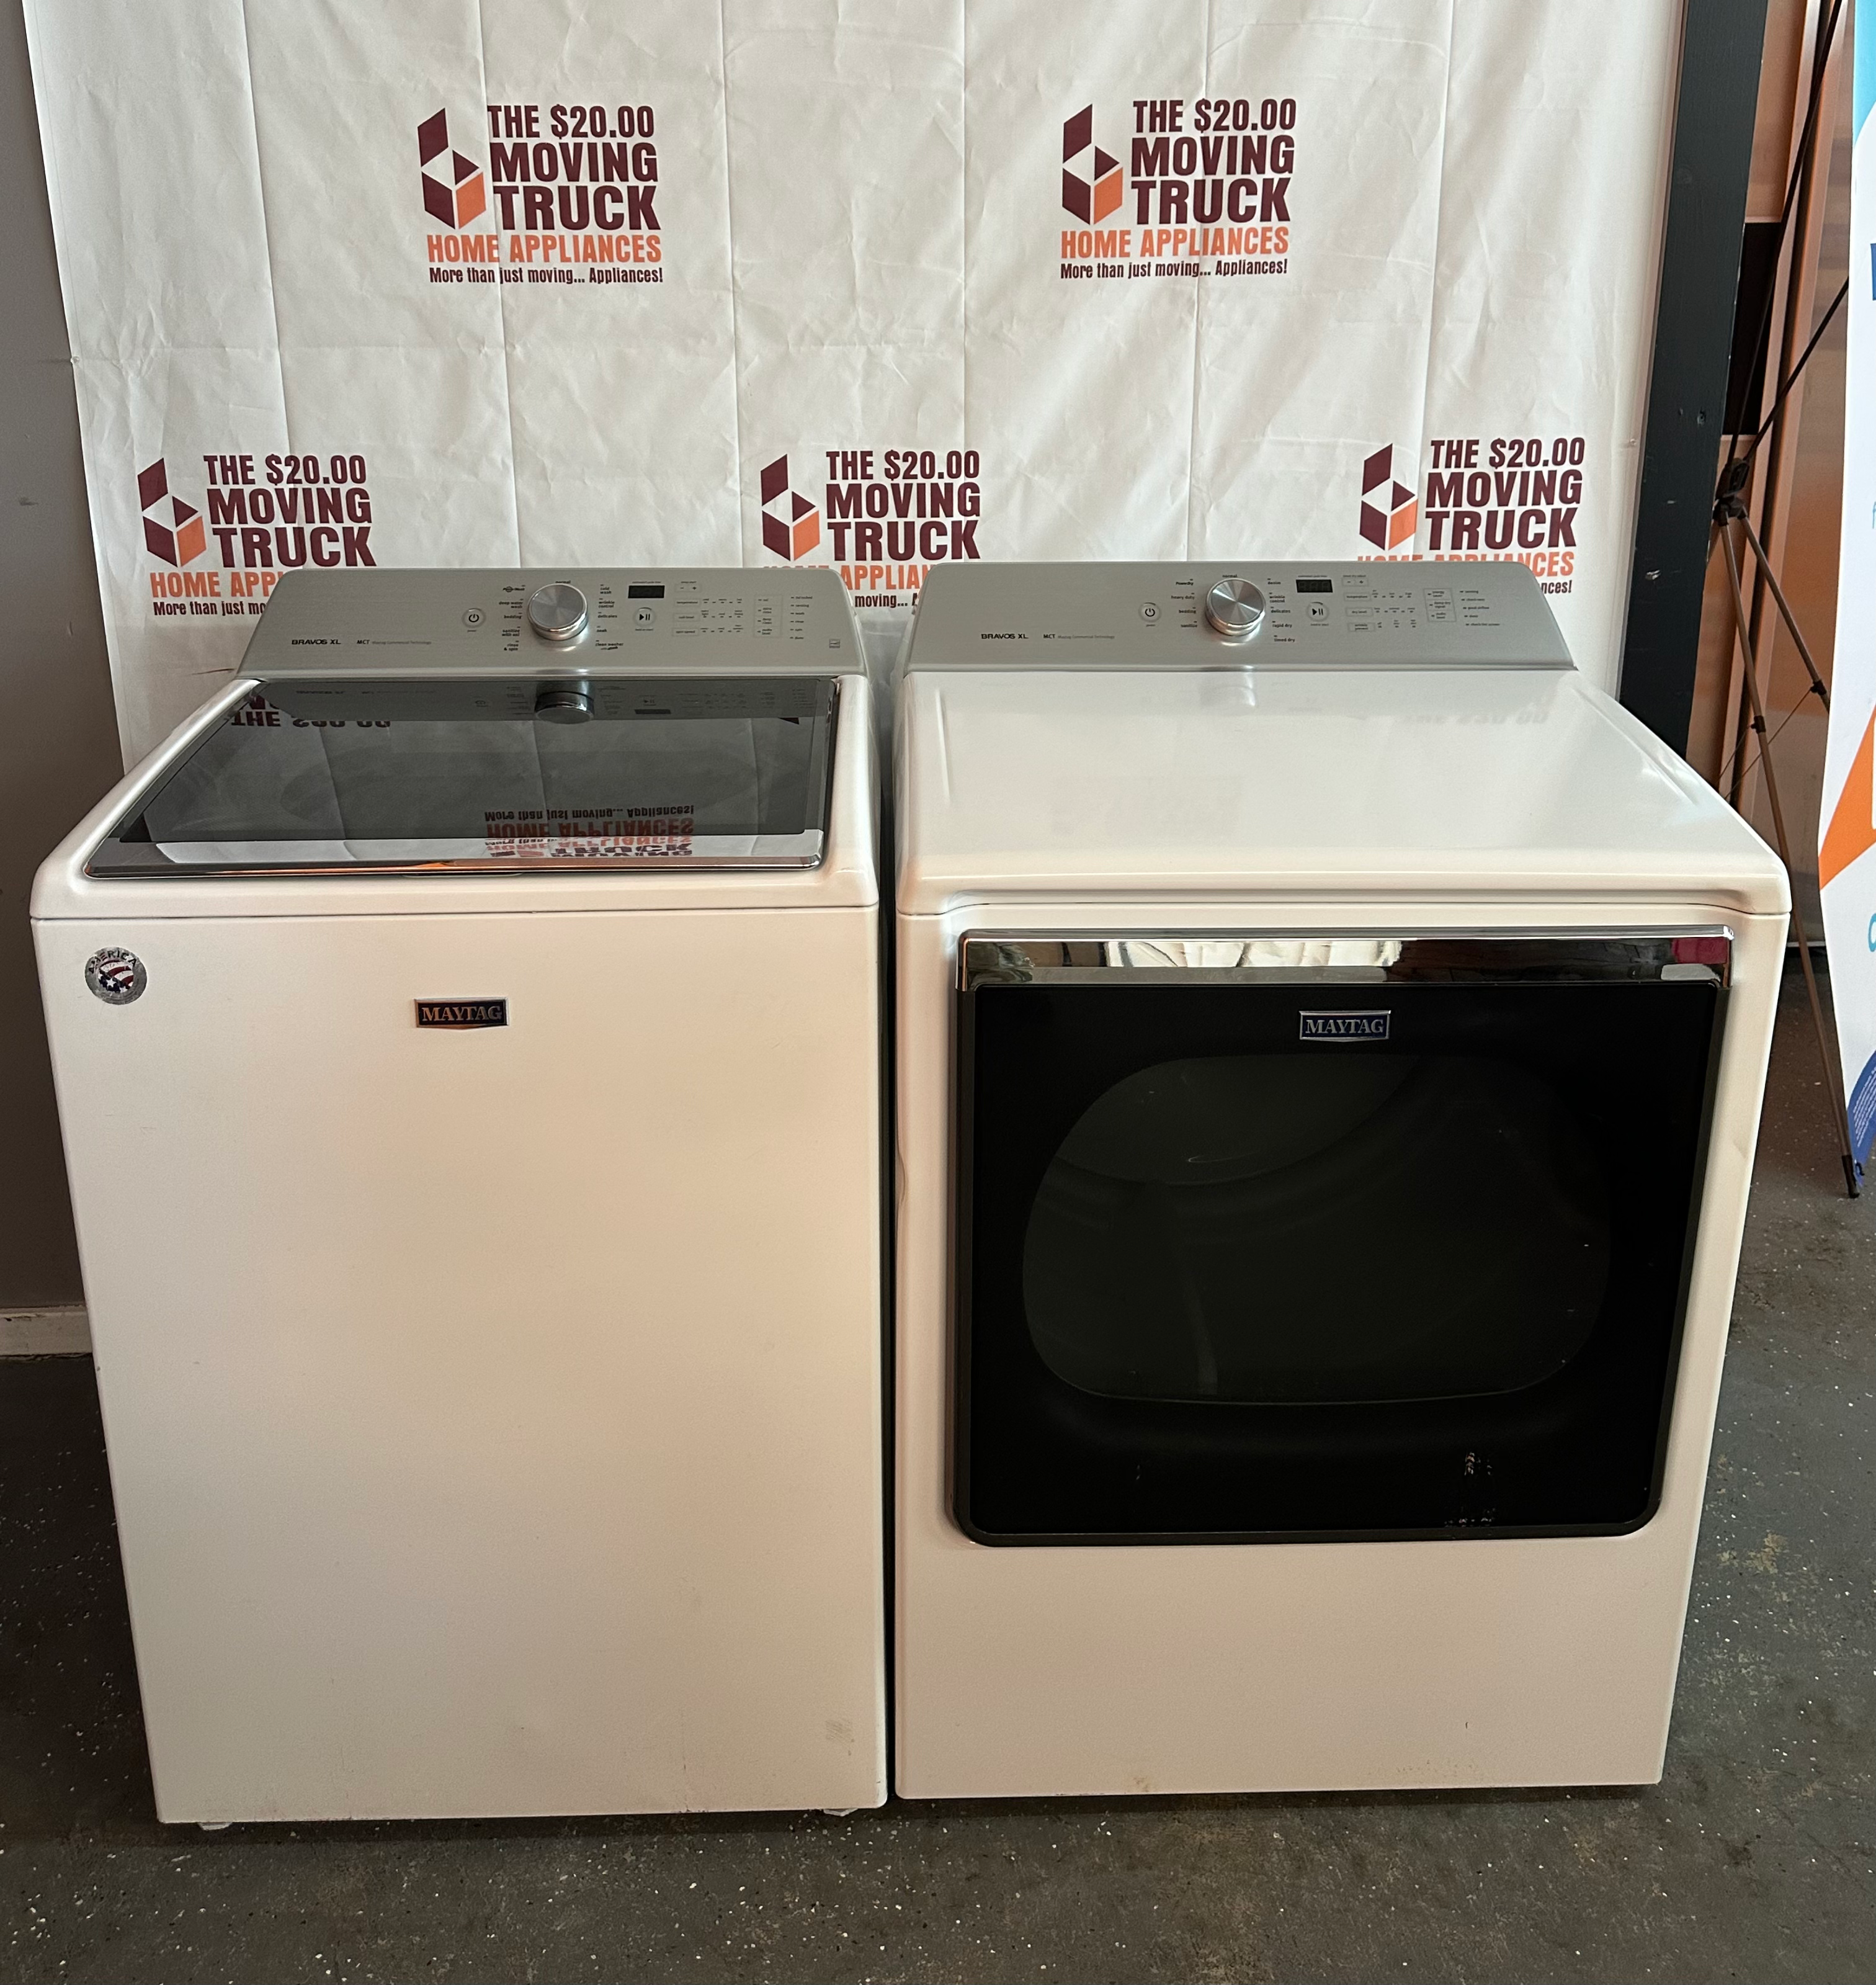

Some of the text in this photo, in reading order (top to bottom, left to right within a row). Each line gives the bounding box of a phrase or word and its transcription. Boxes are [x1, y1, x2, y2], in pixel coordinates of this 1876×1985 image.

[487, 104, 654, 140] THE $20.00
[1133, 98, 1297, 133] THE $20.00
[489, 142, 658, 182] MOVING
[1131, 135, 1295, 177] MOVING
[493, 185, 661, 231] TRUCK
[1131, 177, 1291, 225] TRUCK
[427, 235, 661, 262] HOME APPLIANCES
[1061, 226, 1289, 259] HOME APPLIANCES
[429, 267, 663, 284] More than just moving... Appliances!
[1060, 259, 1287, 279] More than just moving... Appliances!
[203, 454, 366, 486] THE $20.00
[826, 449, 980, 481] THE $20.00
[1431, 437, 1585, 469] THE $20.00
[207, 487, 372, 524] MOVING
[826, 482, 980, 519] MOVING
[1427, 469, 1583, 508] MOVING
[827, 519, 981, 562] TRUCK
[1425, 507, 1578, 550] TRUCK
[212, 526, 377, 568] TRUCK
[150, 571, 221, 598] HOME
[855, 593, 908, 608] moving...
[153, 602, 187, 616] More
[190, 601, 218, 616] than
[221, 601, 244, 616] just
[422, 1005, 502, 1022] MAYTAG
[1305, 1019, 1384, 1034] MAYTAG
